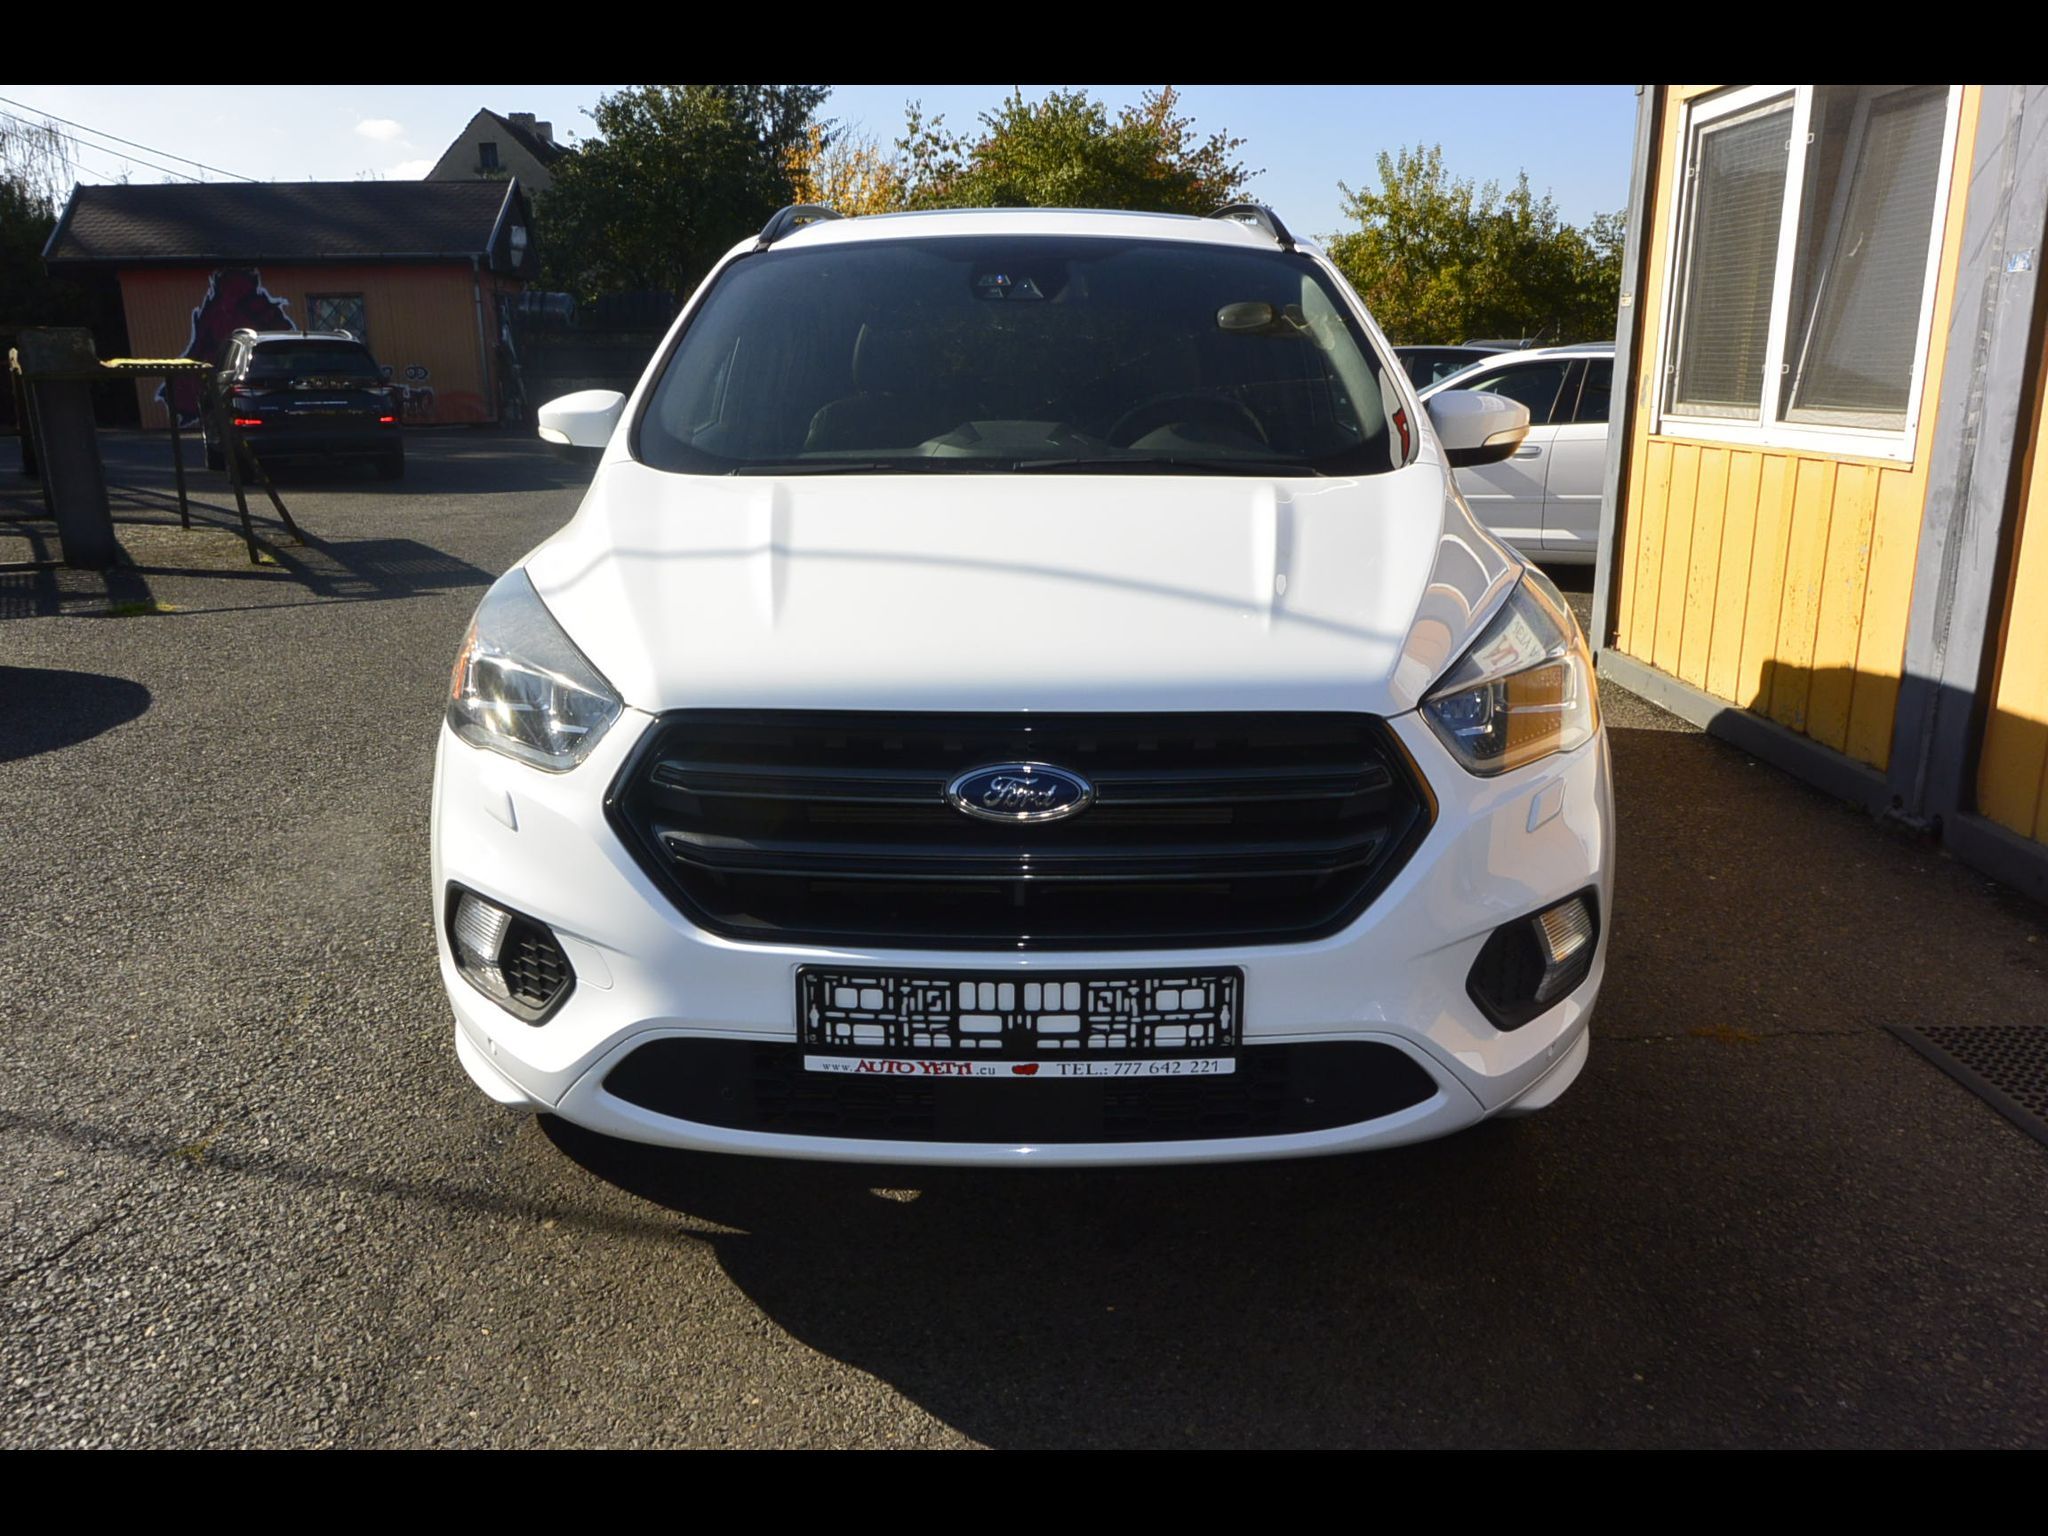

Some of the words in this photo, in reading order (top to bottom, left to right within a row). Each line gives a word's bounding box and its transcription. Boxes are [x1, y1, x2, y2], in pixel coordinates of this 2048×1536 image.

[983, 776, 1058, 807] Ford
[1113, 1062, 1143, 1075] 777
[1148, 1061, 1181, 1075] 642
[1190, 1060, 1219, 1074] 221
